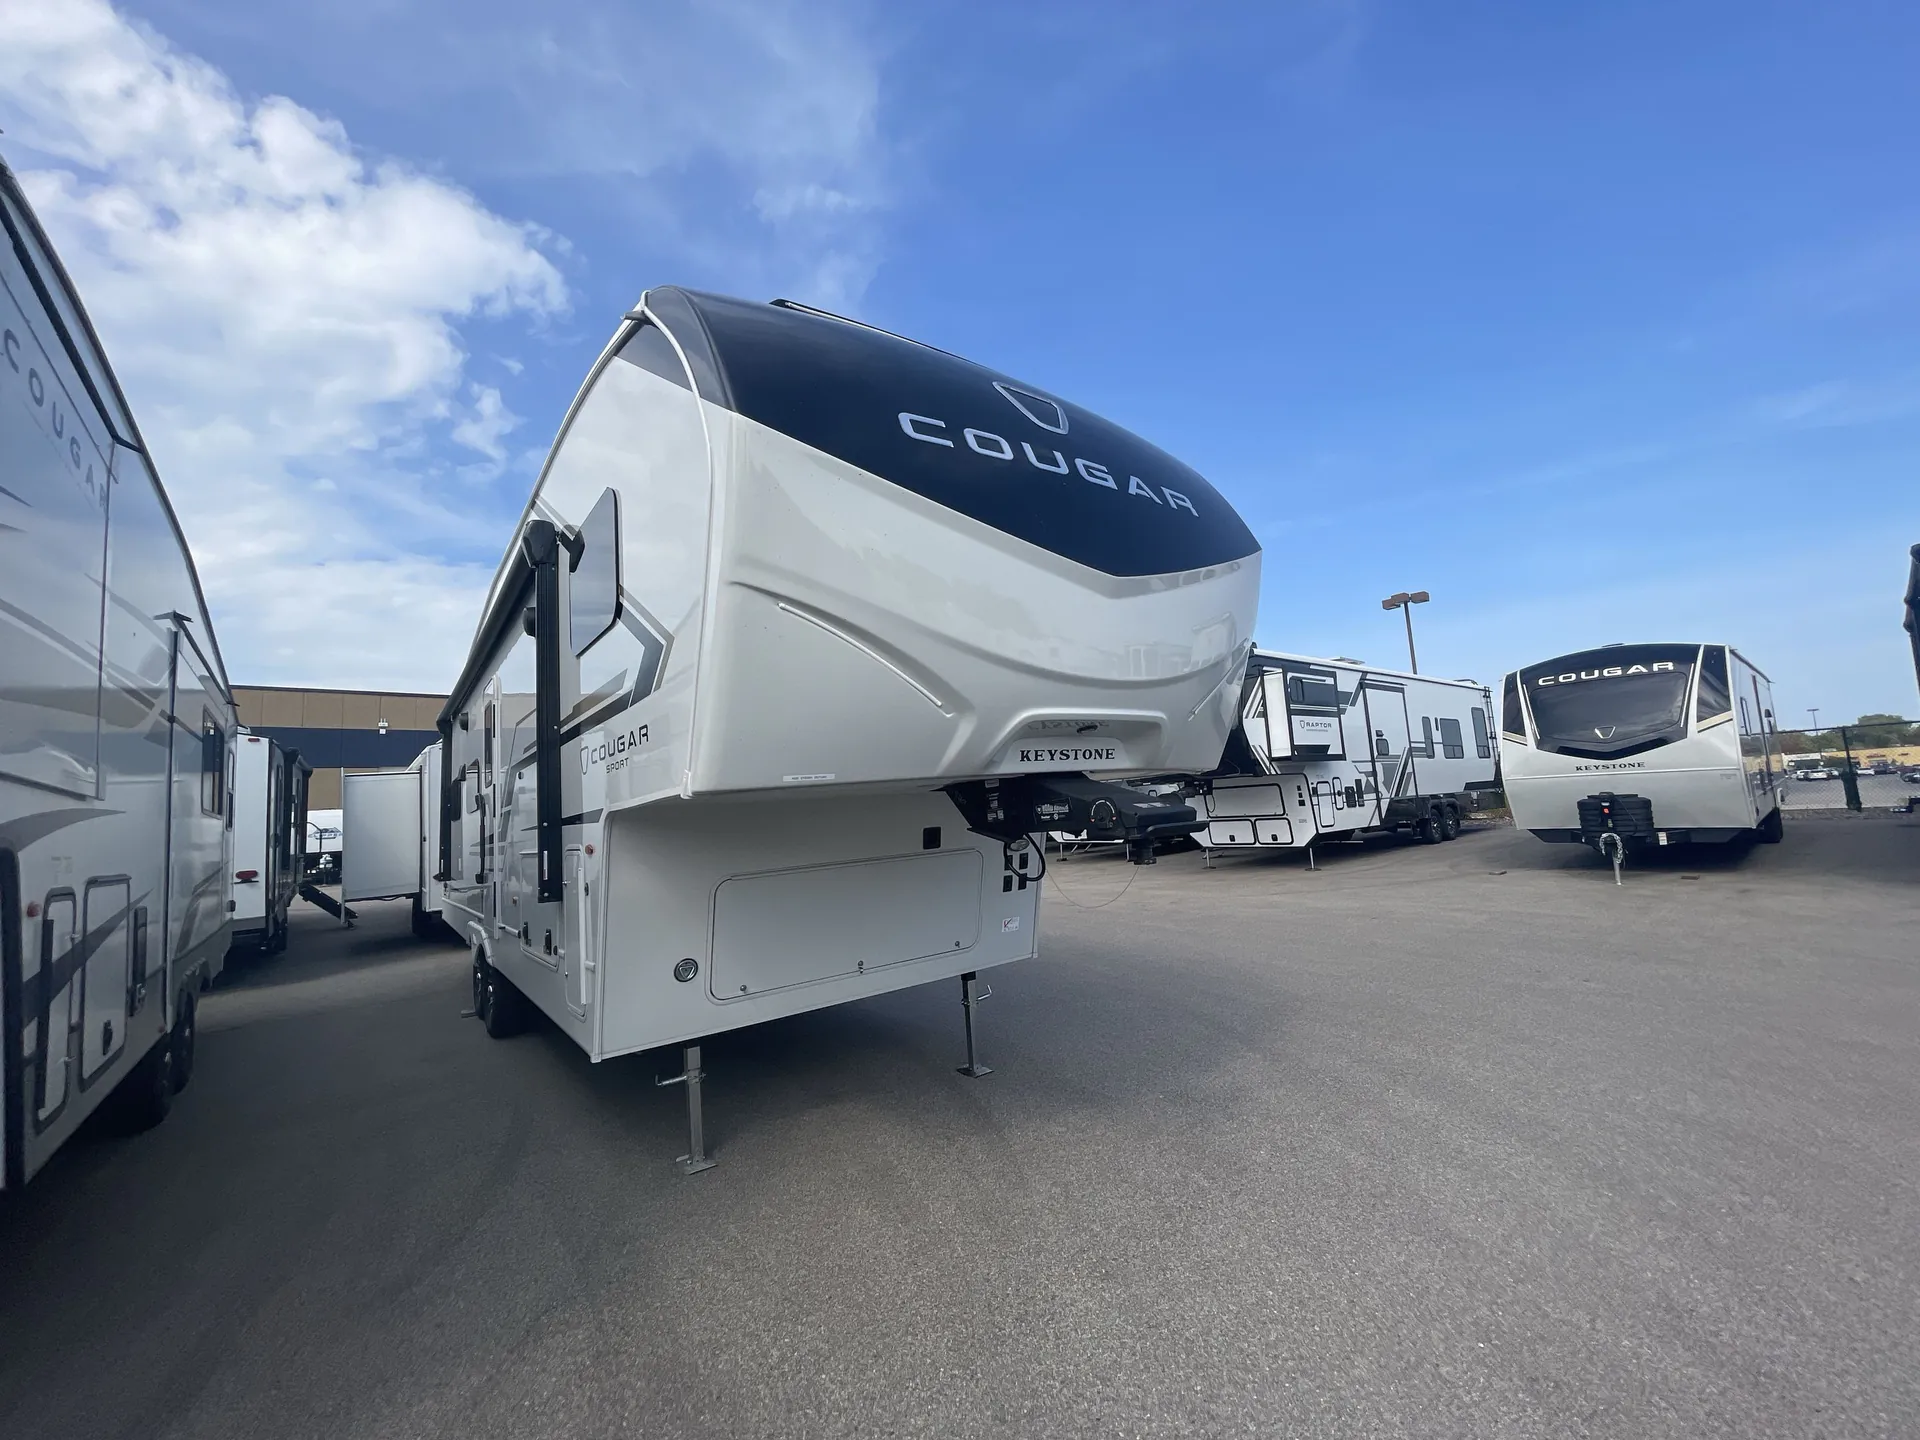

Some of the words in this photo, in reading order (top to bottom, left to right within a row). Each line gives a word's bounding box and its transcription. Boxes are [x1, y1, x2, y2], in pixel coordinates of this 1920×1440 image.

[3, 328, 109, 510] COUGAR
[898, 412, 1199, 517] COUGAR
[1538, 661, 1674, 686] COUGAR
[1306, 721, 1332, 729] RAPTOR
[591, 724, 649, 765] COUGAR
[1019, 748, 1115, 762] KEYSTONE
[606, 757, 629, 774] SPORT
[1575, 761, 1646, 772] KEYSTONE
